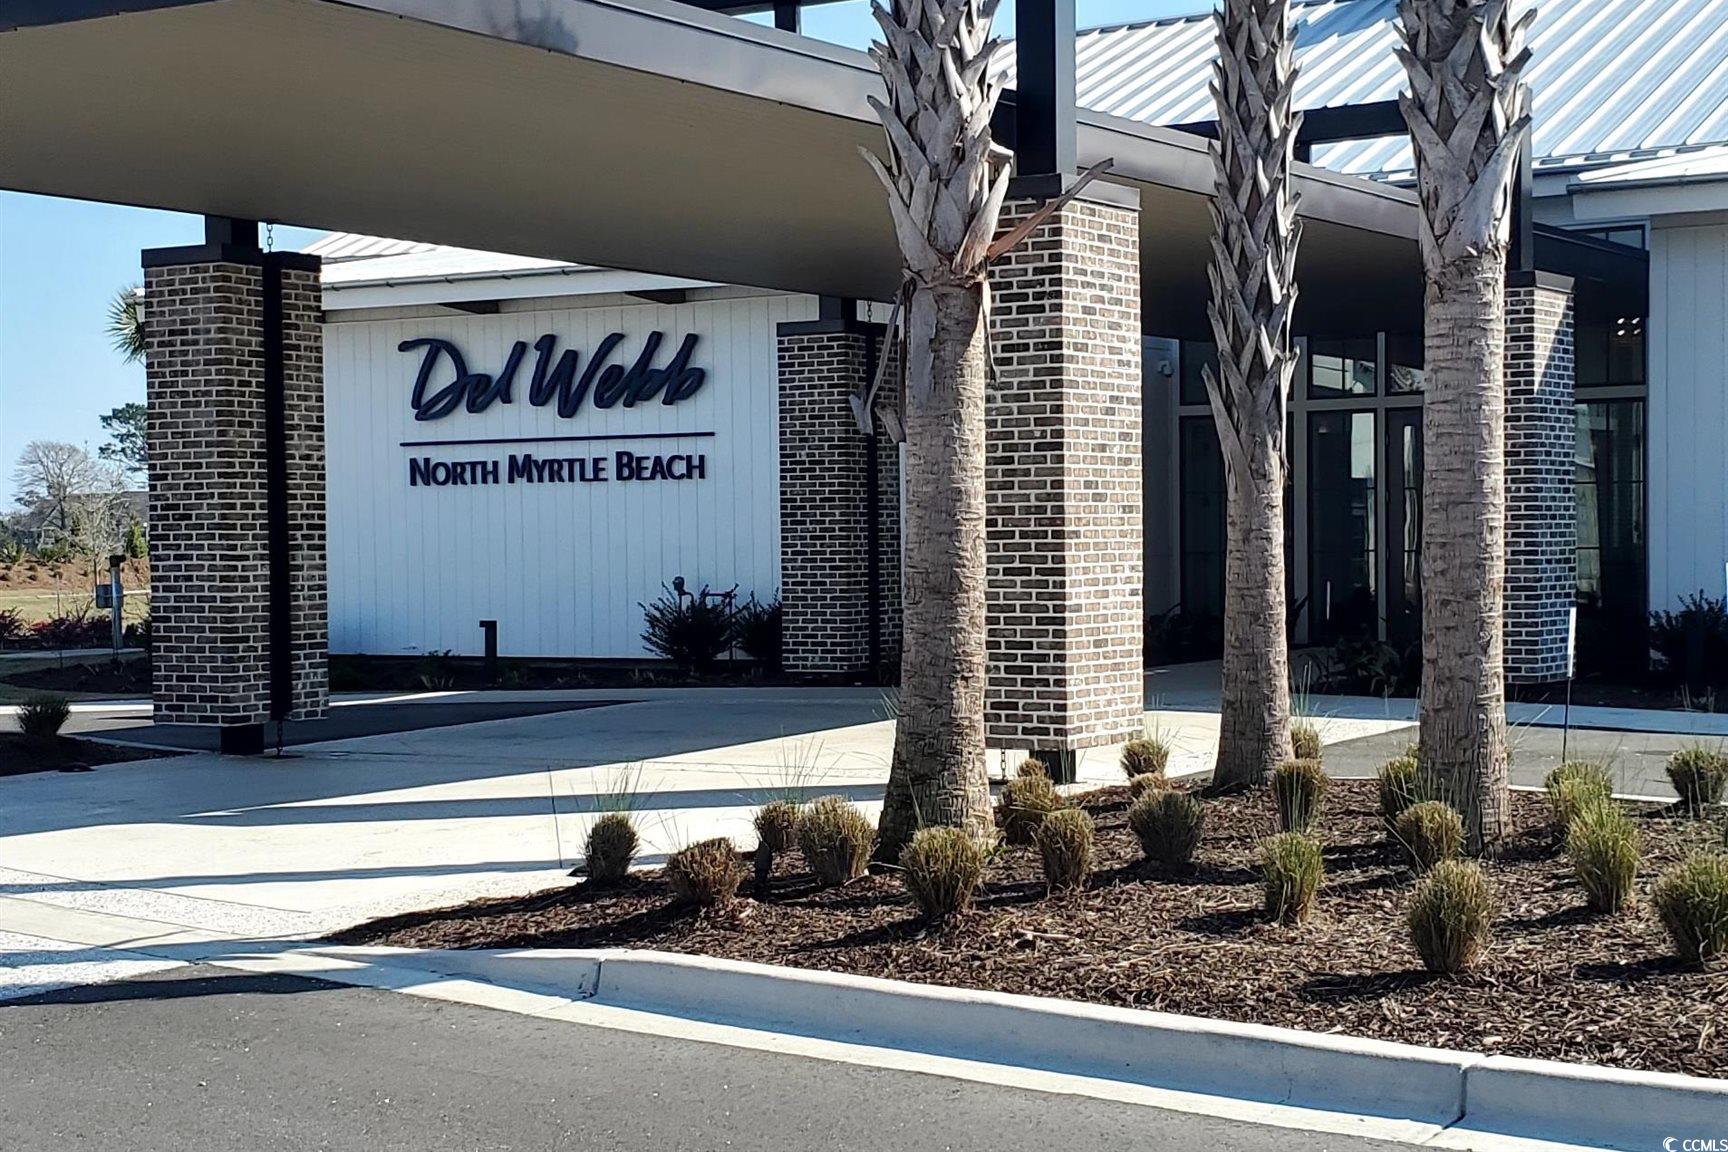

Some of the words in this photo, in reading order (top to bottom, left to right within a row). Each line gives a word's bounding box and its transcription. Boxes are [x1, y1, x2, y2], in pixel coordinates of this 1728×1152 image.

[398, 338, 528, 421] Del
[529, 330, 706, 419] Webb
[409, 457, 499, 487] NORTH
[507, 453, 608, 484] MYRTLE
[615, 450, 706, 481] BEACH
